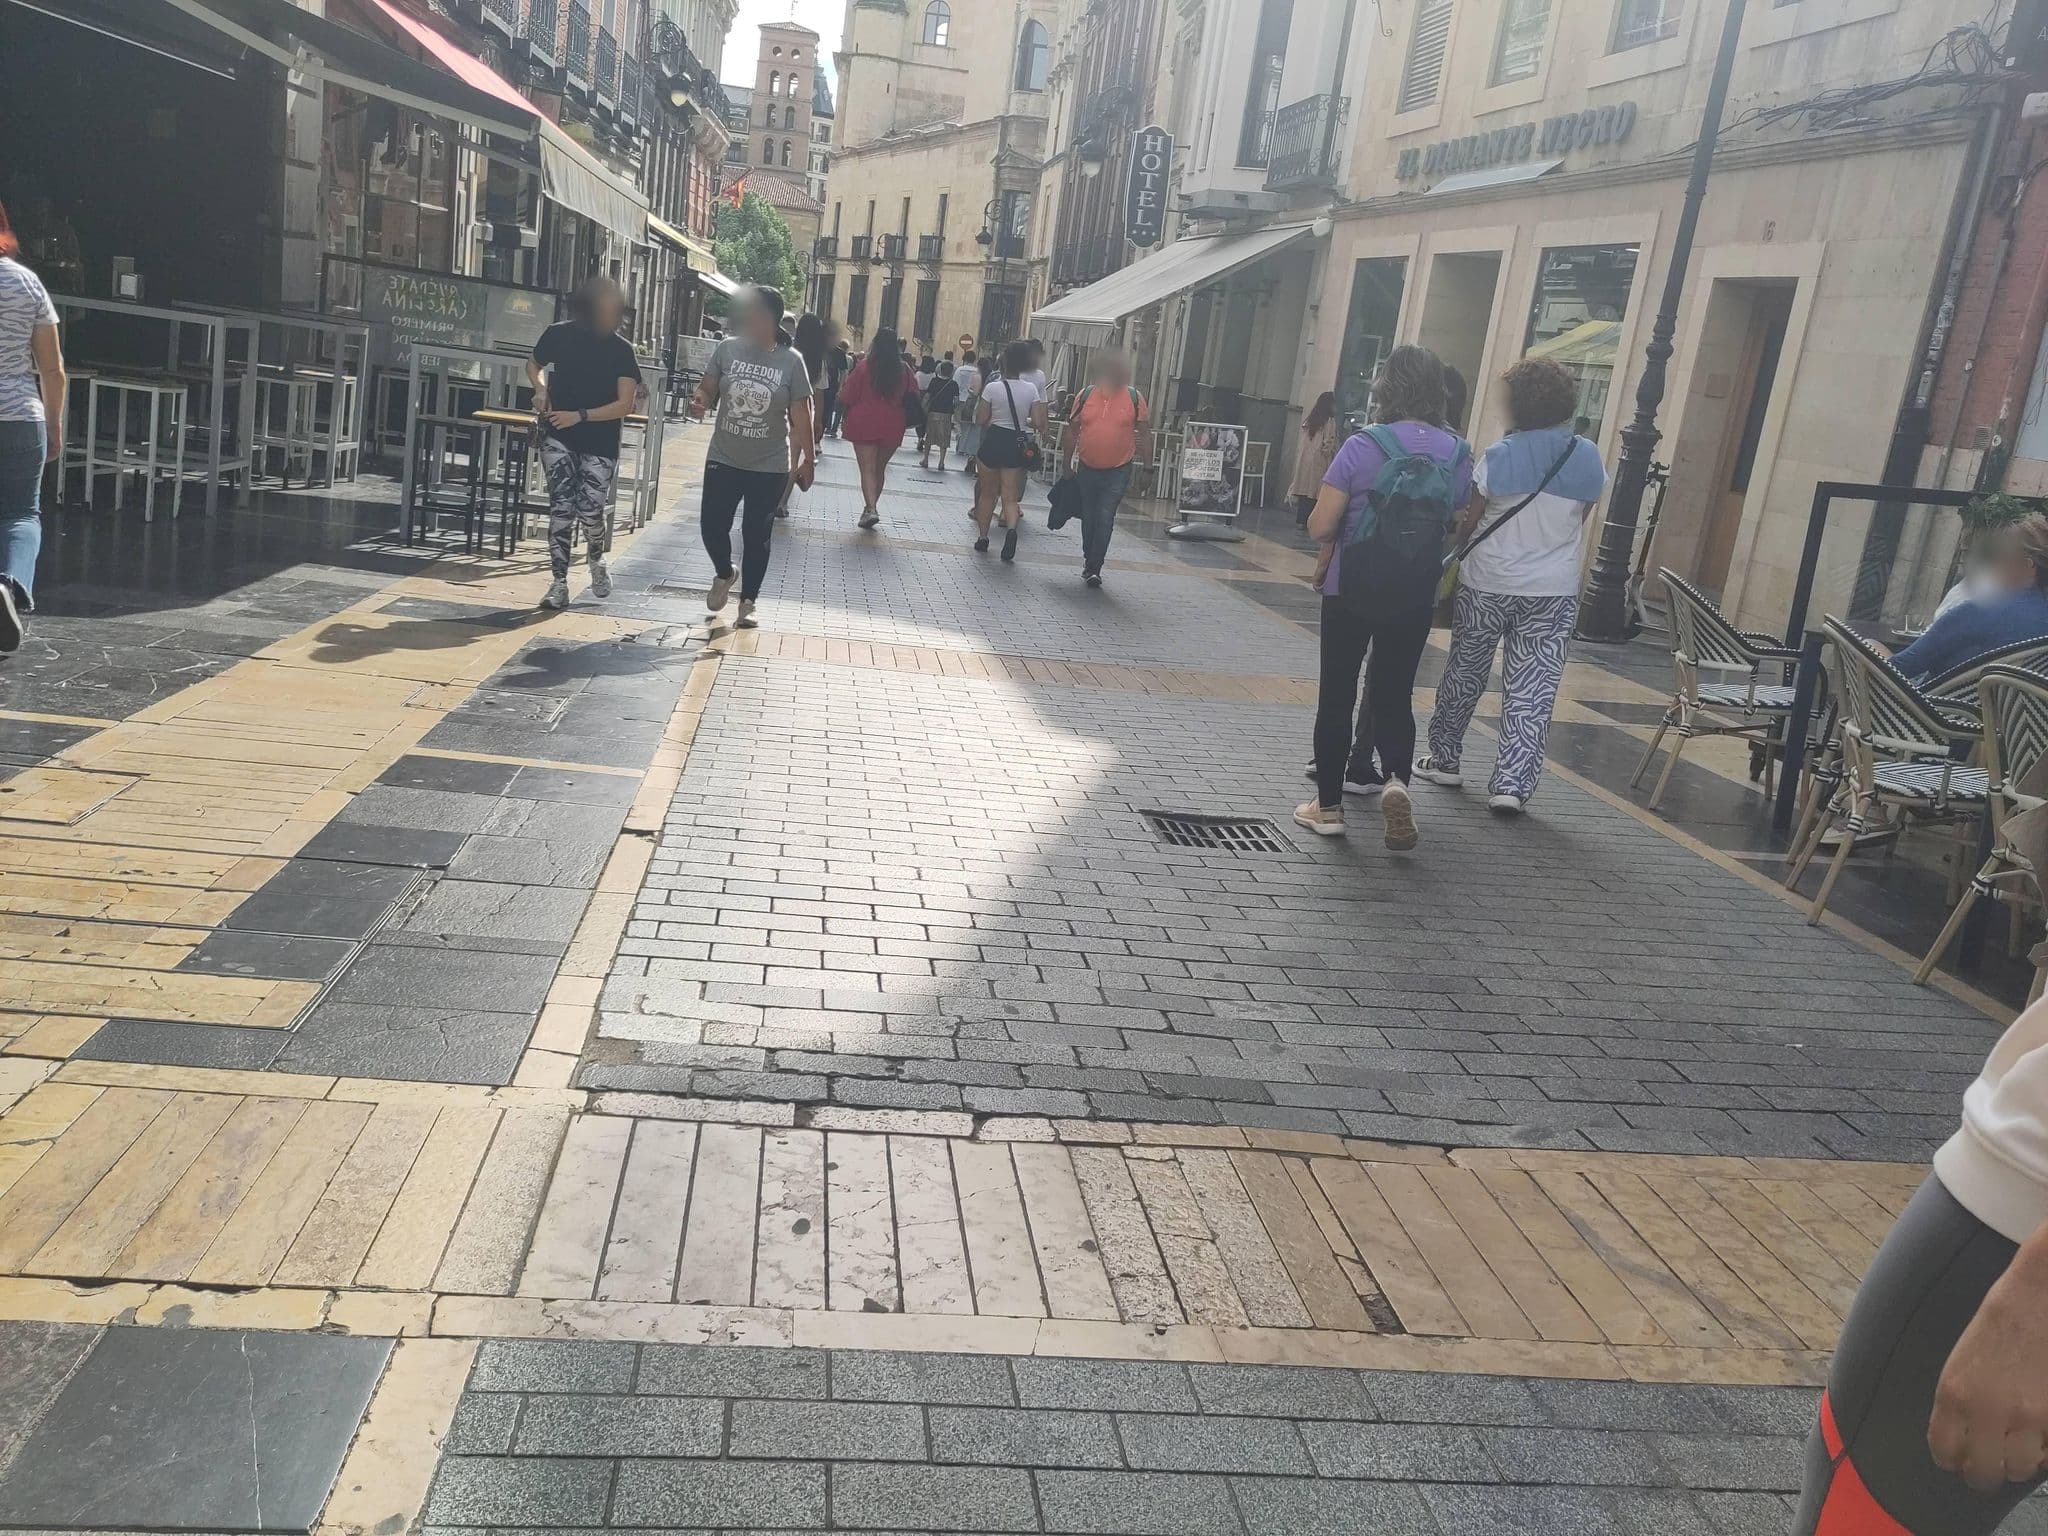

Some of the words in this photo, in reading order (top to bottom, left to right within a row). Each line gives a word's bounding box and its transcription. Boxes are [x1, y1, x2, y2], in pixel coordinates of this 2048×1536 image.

[1396, 147, 1420, 179] EL
[1421, 122, 1537, 176] DIAMANTE
[1537, 101, 1637, 154] NEGRO
[1134, 134, 1165, 226] HOTEL
[728, 359, 783, 386] FREEDOM
[742, 426, 769, 438] MUSIC
